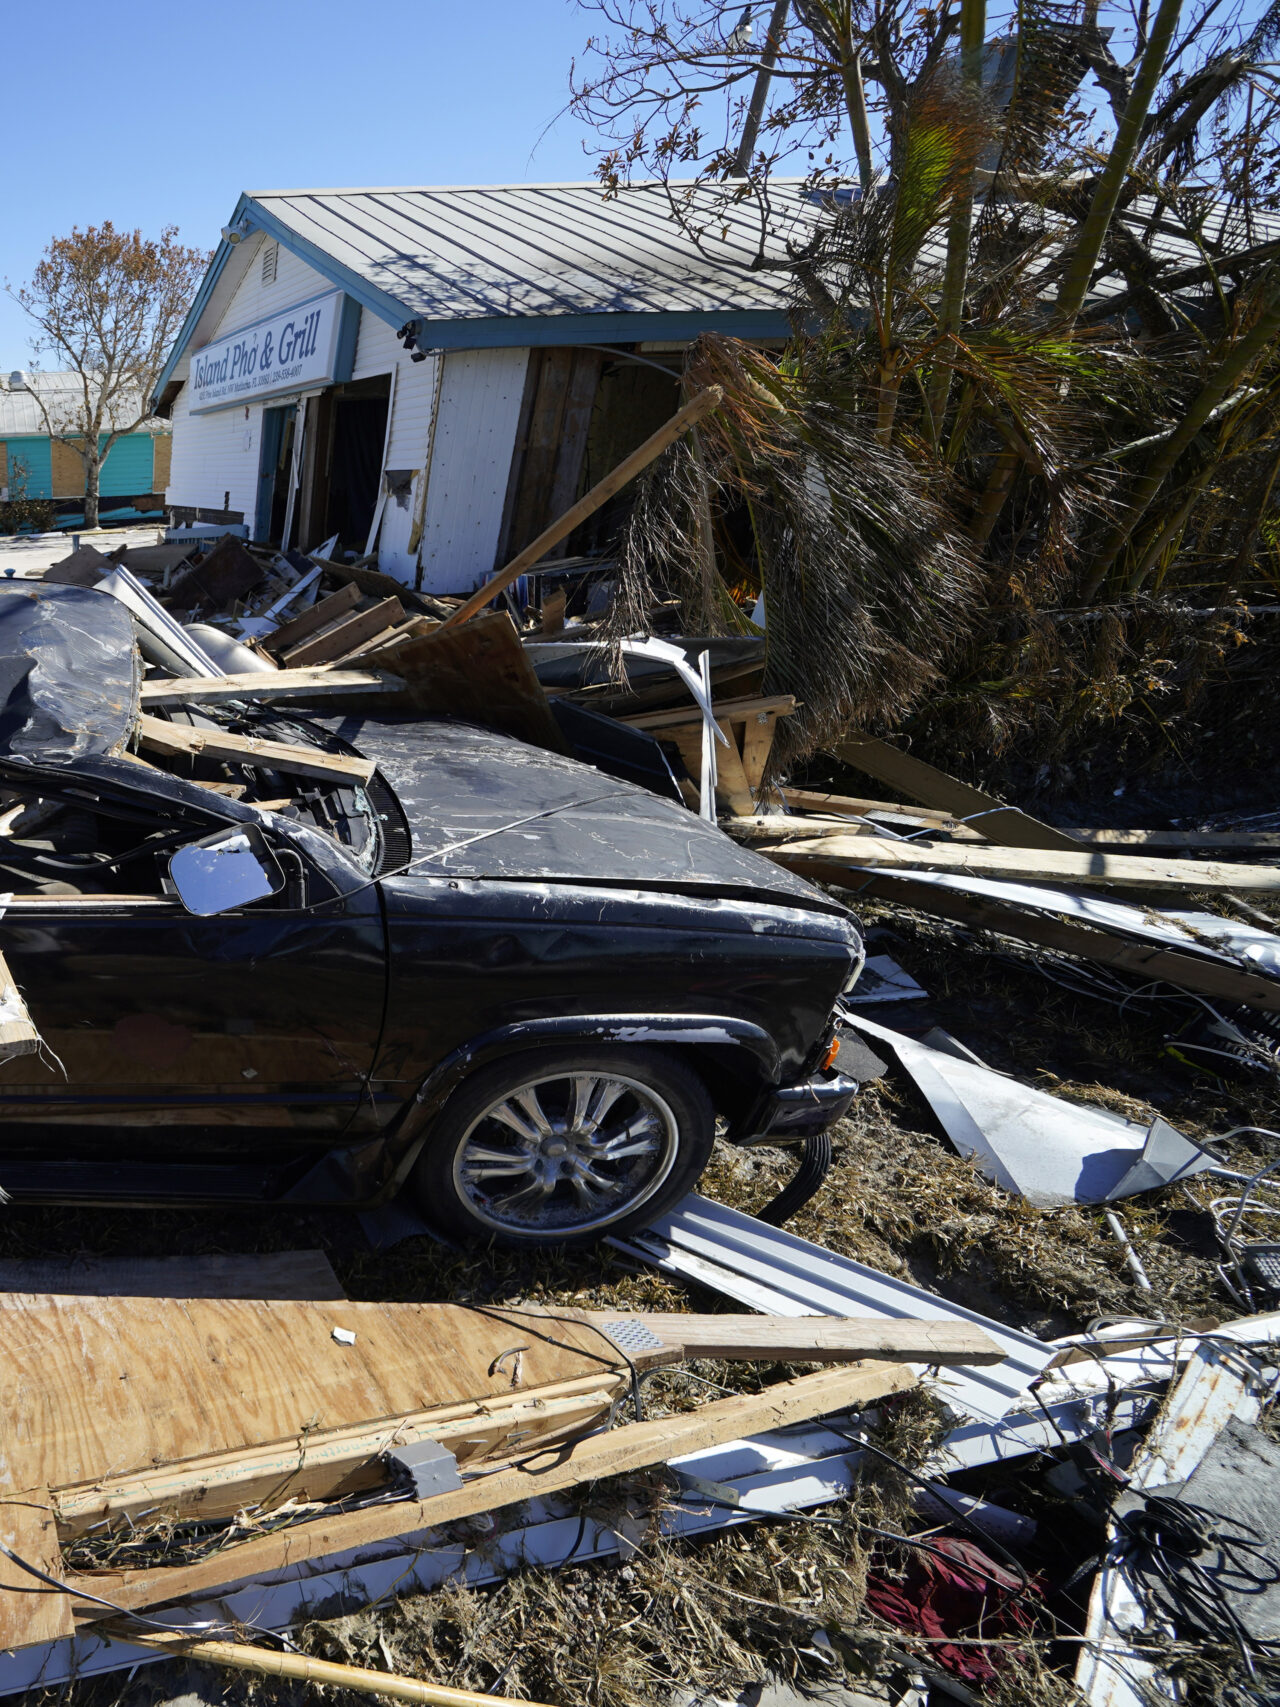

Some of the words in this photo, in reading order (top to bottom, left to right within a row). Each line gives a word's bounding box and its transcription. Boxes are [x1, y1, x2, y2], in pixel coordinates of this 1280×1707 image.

[194, 348, 230, 390] Island
[259, 331, 274, 371] &
[278, 309, 321, 366] Grill
